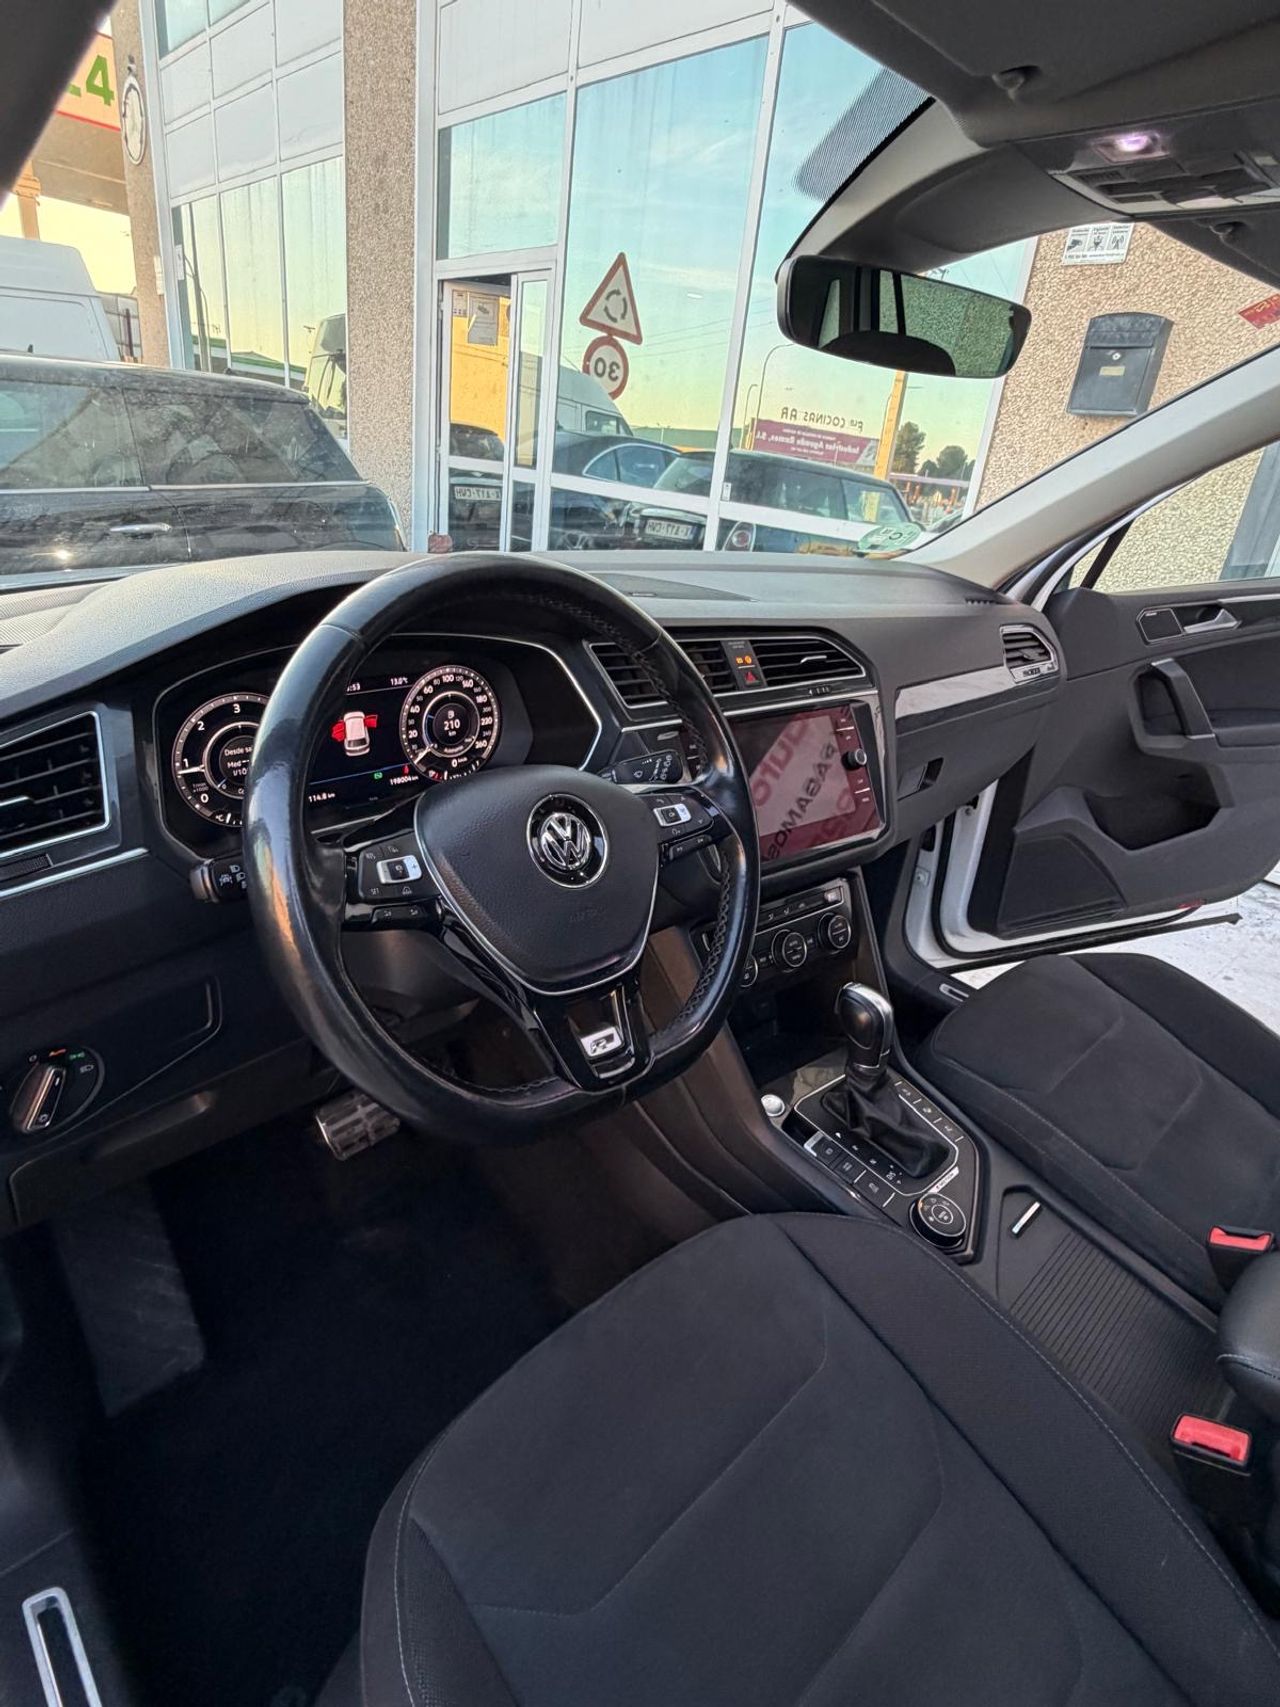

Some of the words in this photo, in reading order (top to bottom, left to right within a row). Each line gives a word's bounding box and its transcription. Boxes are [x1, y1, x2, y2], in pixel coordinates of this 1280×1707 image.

[423, 686, 434, 694] 60
[233, 703, 241, 714] 3
[197, 721, 205, 731] 2
[444, 720, 461, 731] 210
[481, 717, 493, 726] 220
[408, 730, 418, 739] 20
[183, 758, 190, 768] 1
[451, 758, 458, 768] 0
[200, 793, 209, 803] 0
